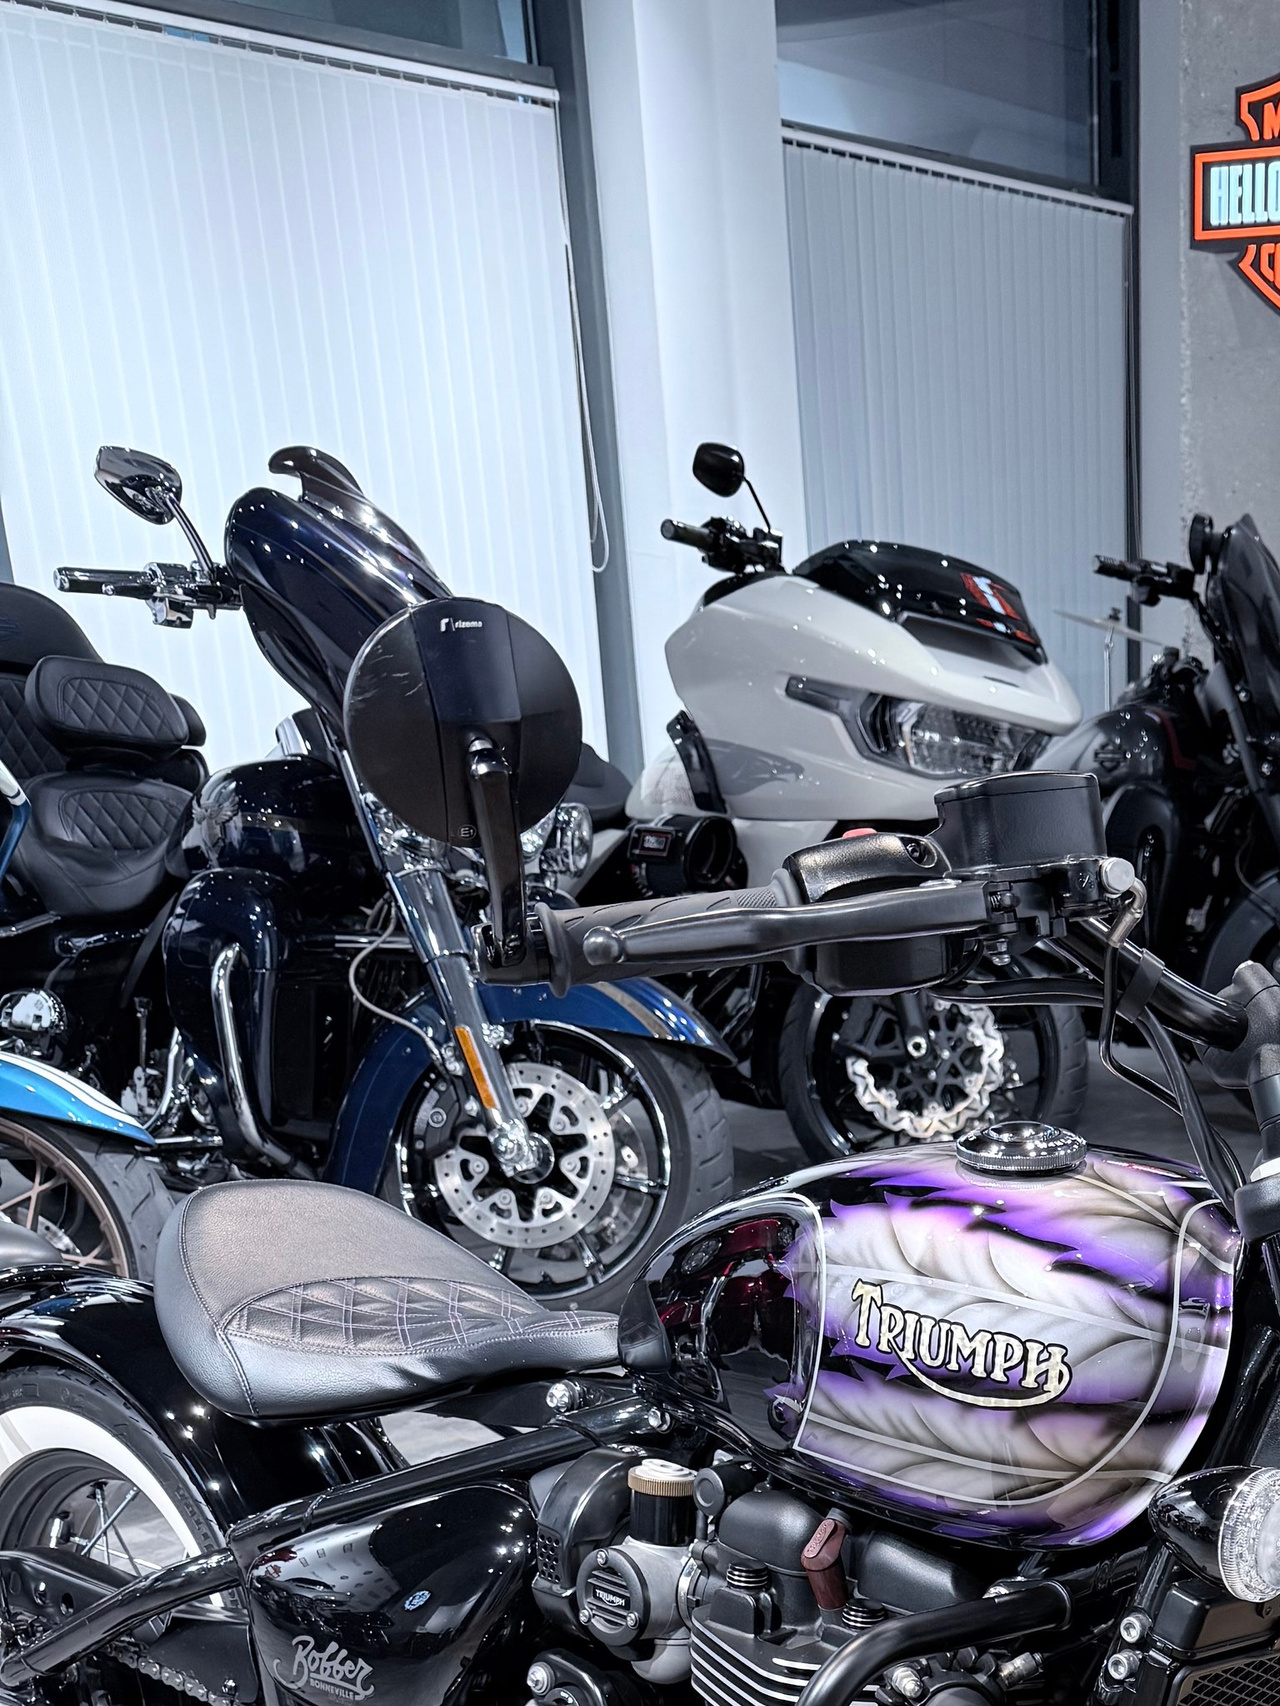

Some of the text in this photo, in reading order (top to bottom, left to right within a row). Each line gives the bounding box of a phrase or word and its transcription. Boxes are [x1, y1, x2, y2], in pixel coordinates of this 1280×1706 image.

[849, 1279, 1073, 1408] TRIUMPH
[595, 1589, 626, 1607] TRIUMPH
[273, 1635, 375, 1701] Bobber
[309, 1678, 355, 1701] BONNEVILLE
